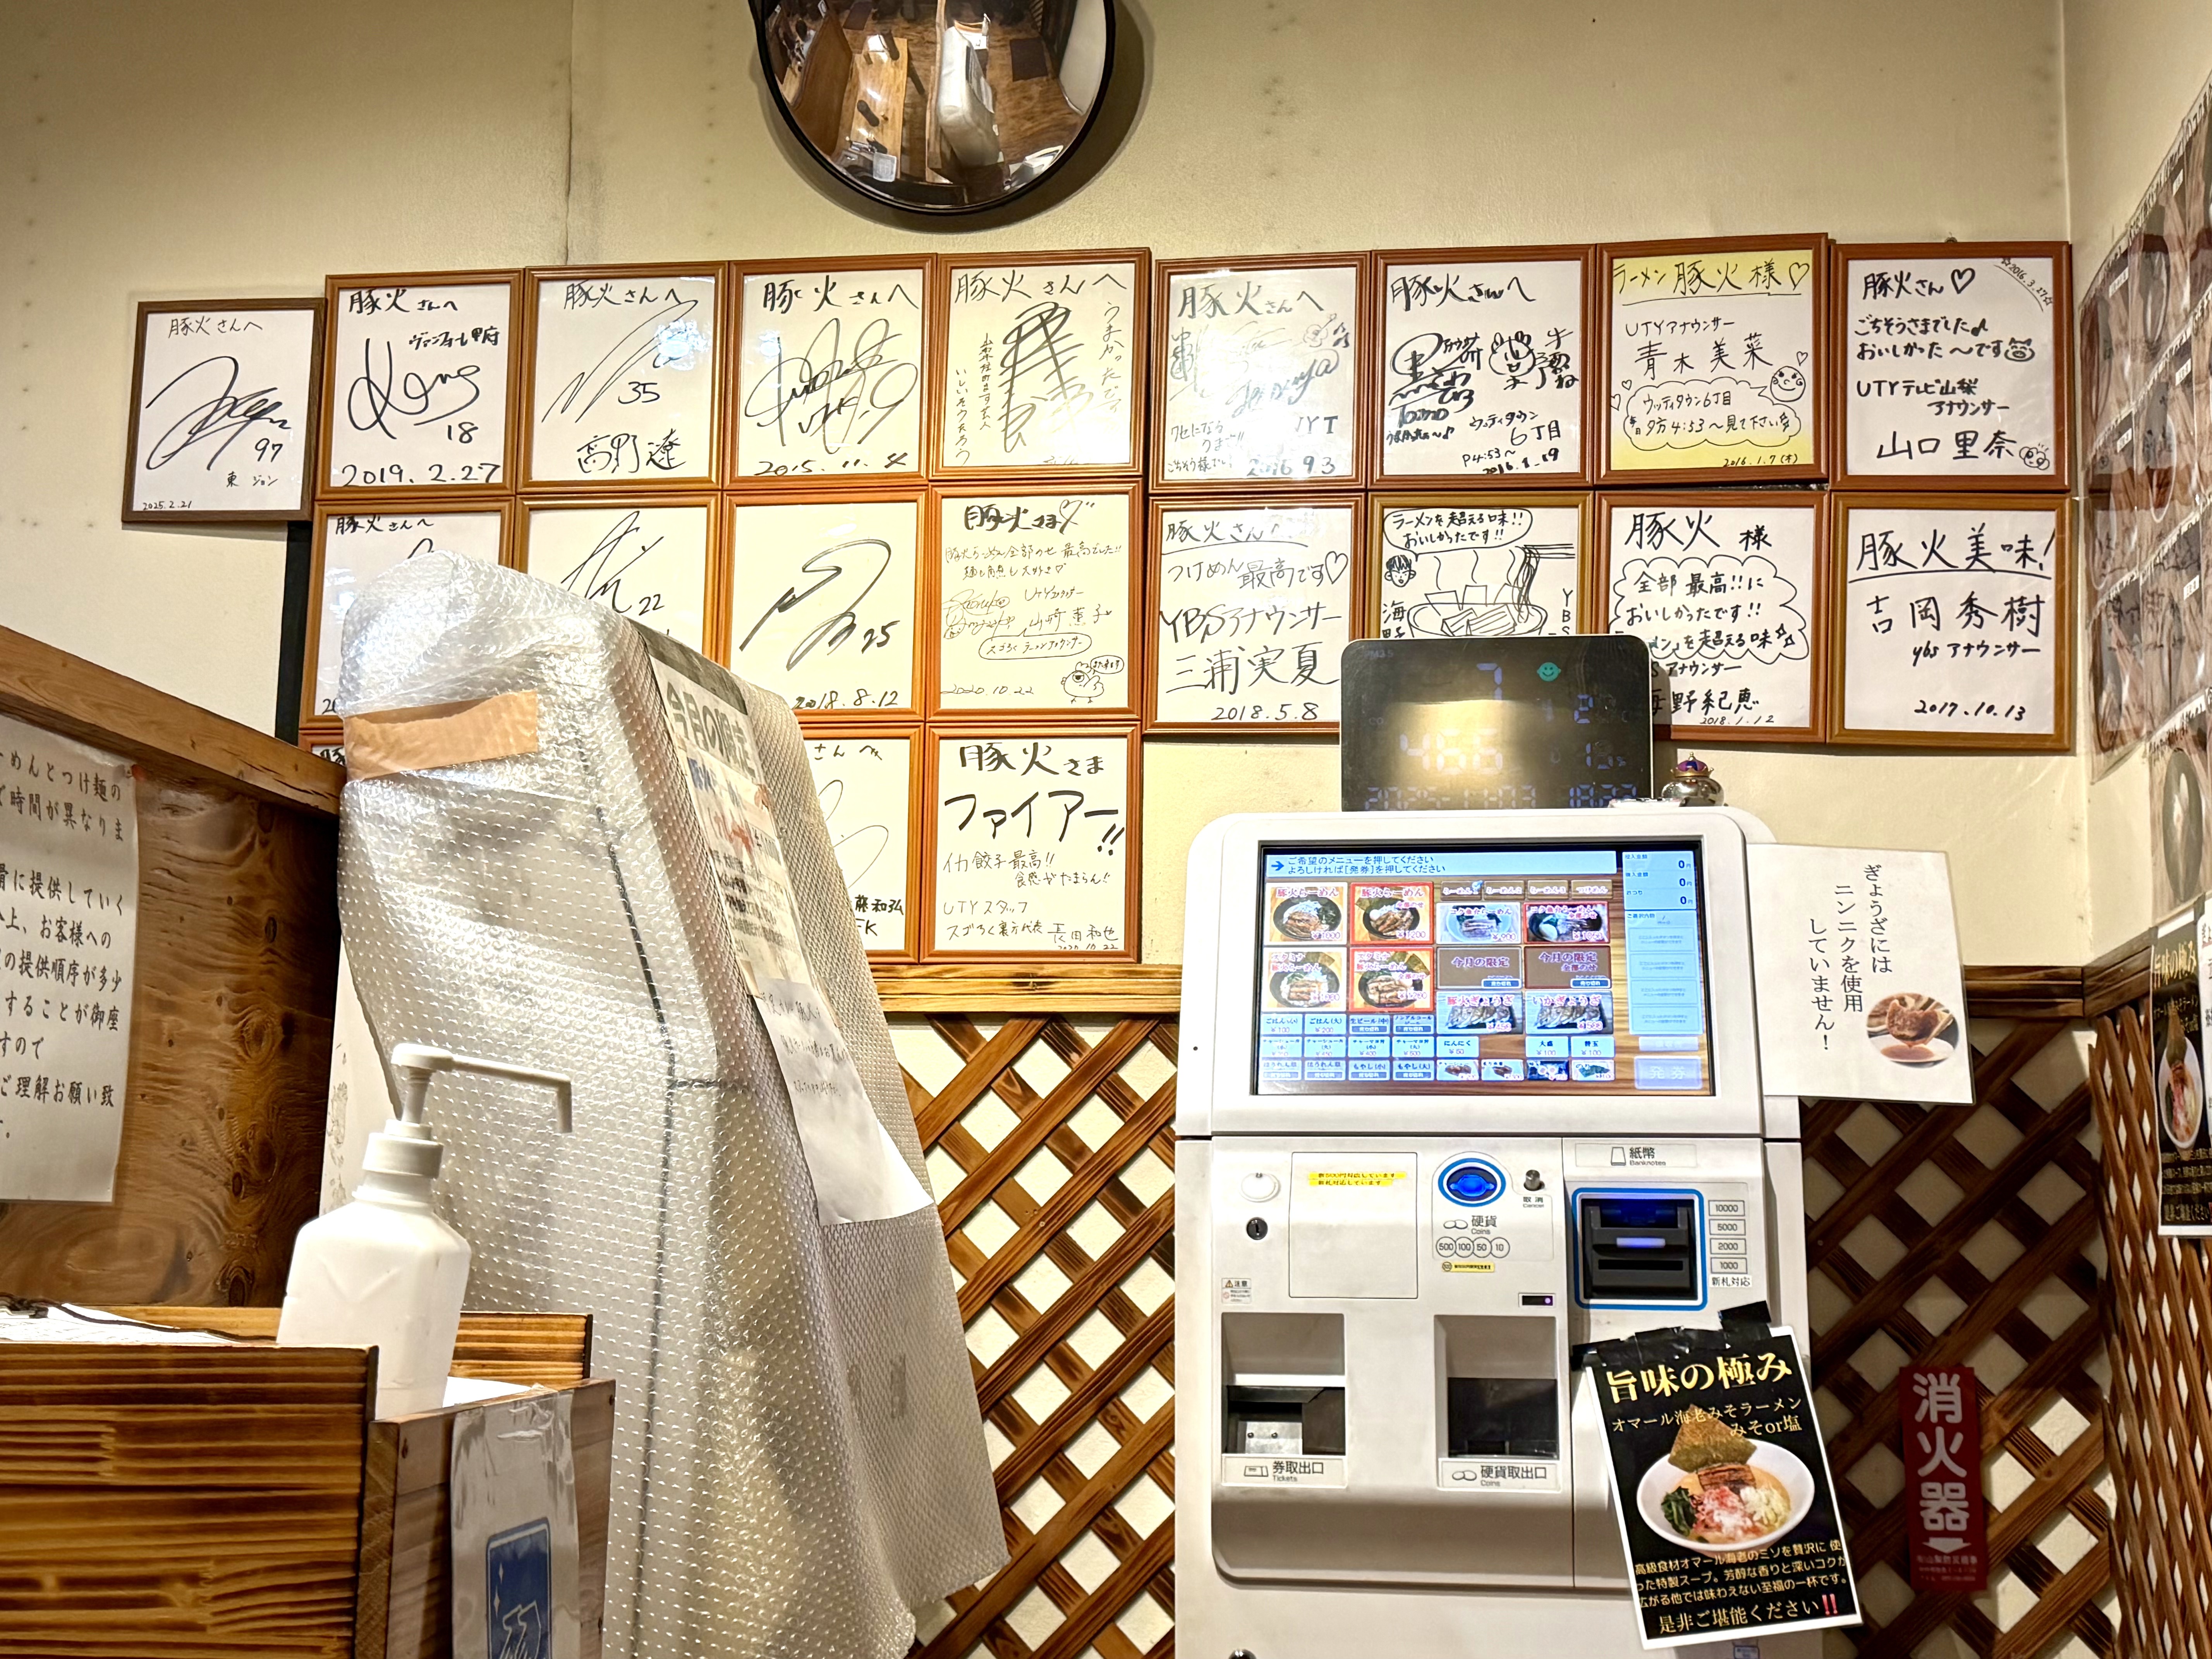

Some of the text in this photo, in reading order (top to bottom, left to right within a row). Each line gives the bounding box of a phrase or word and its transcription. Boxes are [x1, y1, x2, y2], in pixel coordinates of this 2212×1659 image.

[955, 270, 1127, 304] 豚火さんへ
[1863, 271, 1944, 299] 豚火さん
[168, 315, 263, 338] 豚火さんへ
[1626, 317, 1735, 337] UTYアナウンサー
[619, 381, 660, 404] 35
[1927, 399, 2009, 416] アナウンサー
[448, 422, 478, 444] 18
[255, 438, 283, 462] 97
[1877, 430, 2017, 460] 山口里奈
[639, 594, 665, 616] 22
[1867, 591, 2045, 637] 吉岡秀樹
[861, 620, 900, 654] 25
[959, 742, 1104, 776] 豚火さま
[0, 750, 120, 802] めんとつけ麺の
[0, 907, 111, 949] 上、お客様への
[1863, 864, 1893, 974] ぎょうざには
[1834, 884, 1863, 1012] ニンニクを使用
[1715, 1204, 1738, 1213] 10000
[1472, 1215, 1497, 1228] 硬貨
[1717, 1223, 1738, 1231] 5000
[1718, 1243, 1738, 1251] 2000
[1720, 1261, 1738, 1270] 1000
[1606, 1351, 1792, 1405] 旨味の極み
[1611, 1397, 1802, 1433] オマール海老みそラーメン
[1730, 1415, 1802, 1438] みそor塩
[1913, 1372, 1970, 1531] 消火器
[1273, 1461, 1324, 1475] 券取出口
[1480, 1466, 1547, 1479] 硬貨取出口
